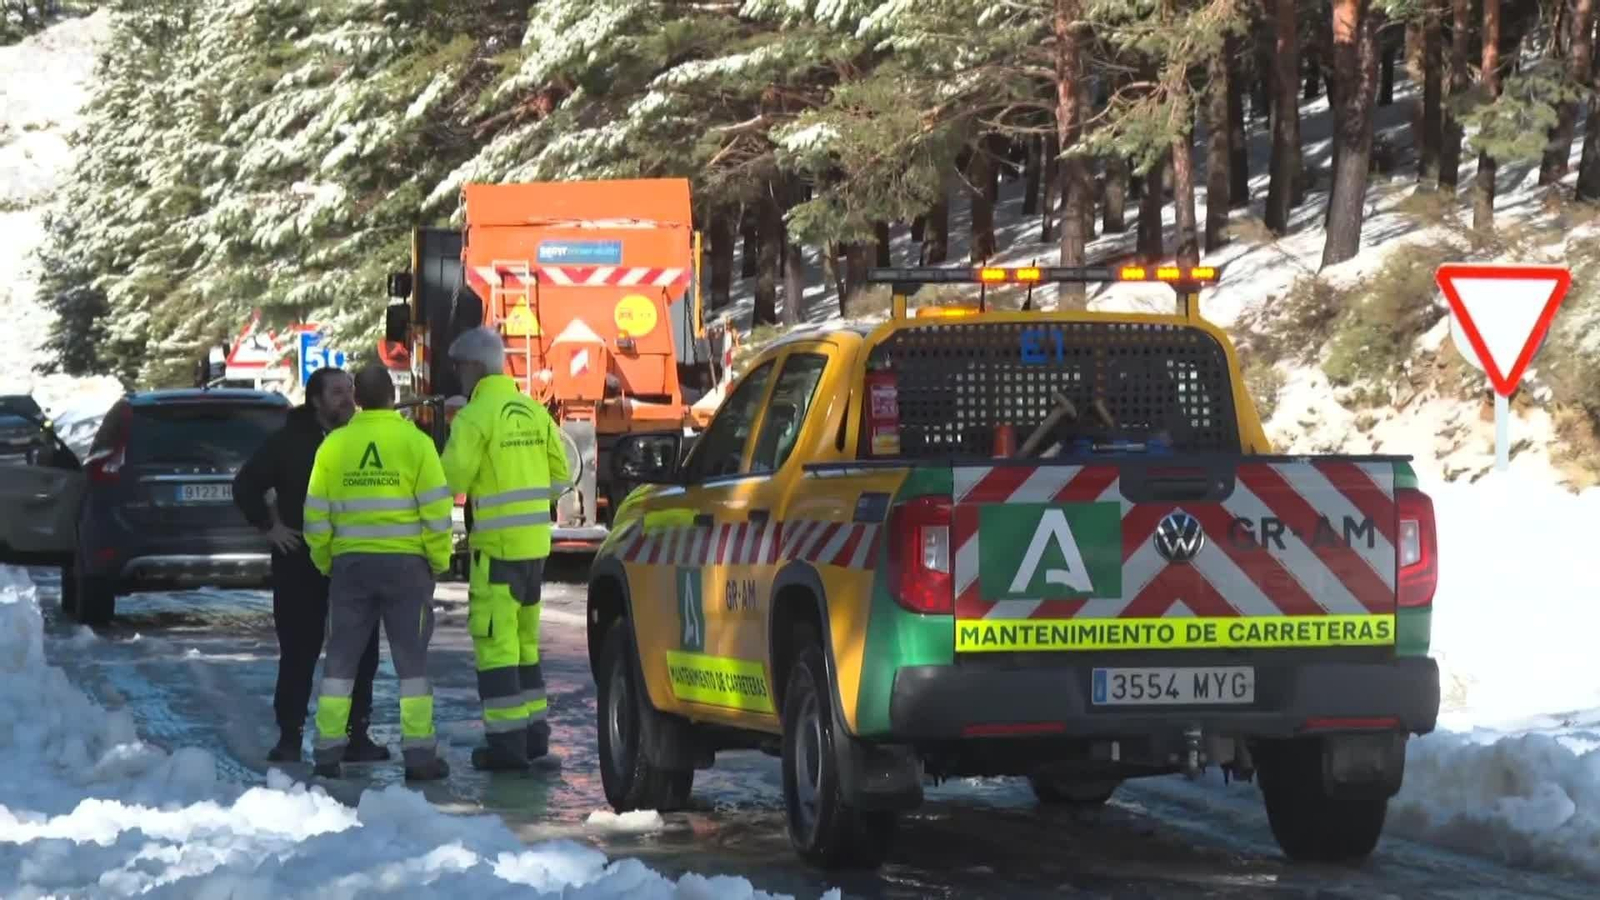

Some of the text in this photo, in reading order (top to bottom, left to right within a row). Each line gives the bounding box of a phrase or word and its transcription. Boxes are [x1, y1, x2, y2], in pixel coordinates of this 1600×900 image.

[1020, 328, 1064, 367] E1
[960, 620, 1390, 646] MANTENIMIENTO DE CARRETERAS
[1112, 672, 1246, 699] 3554 MYG
